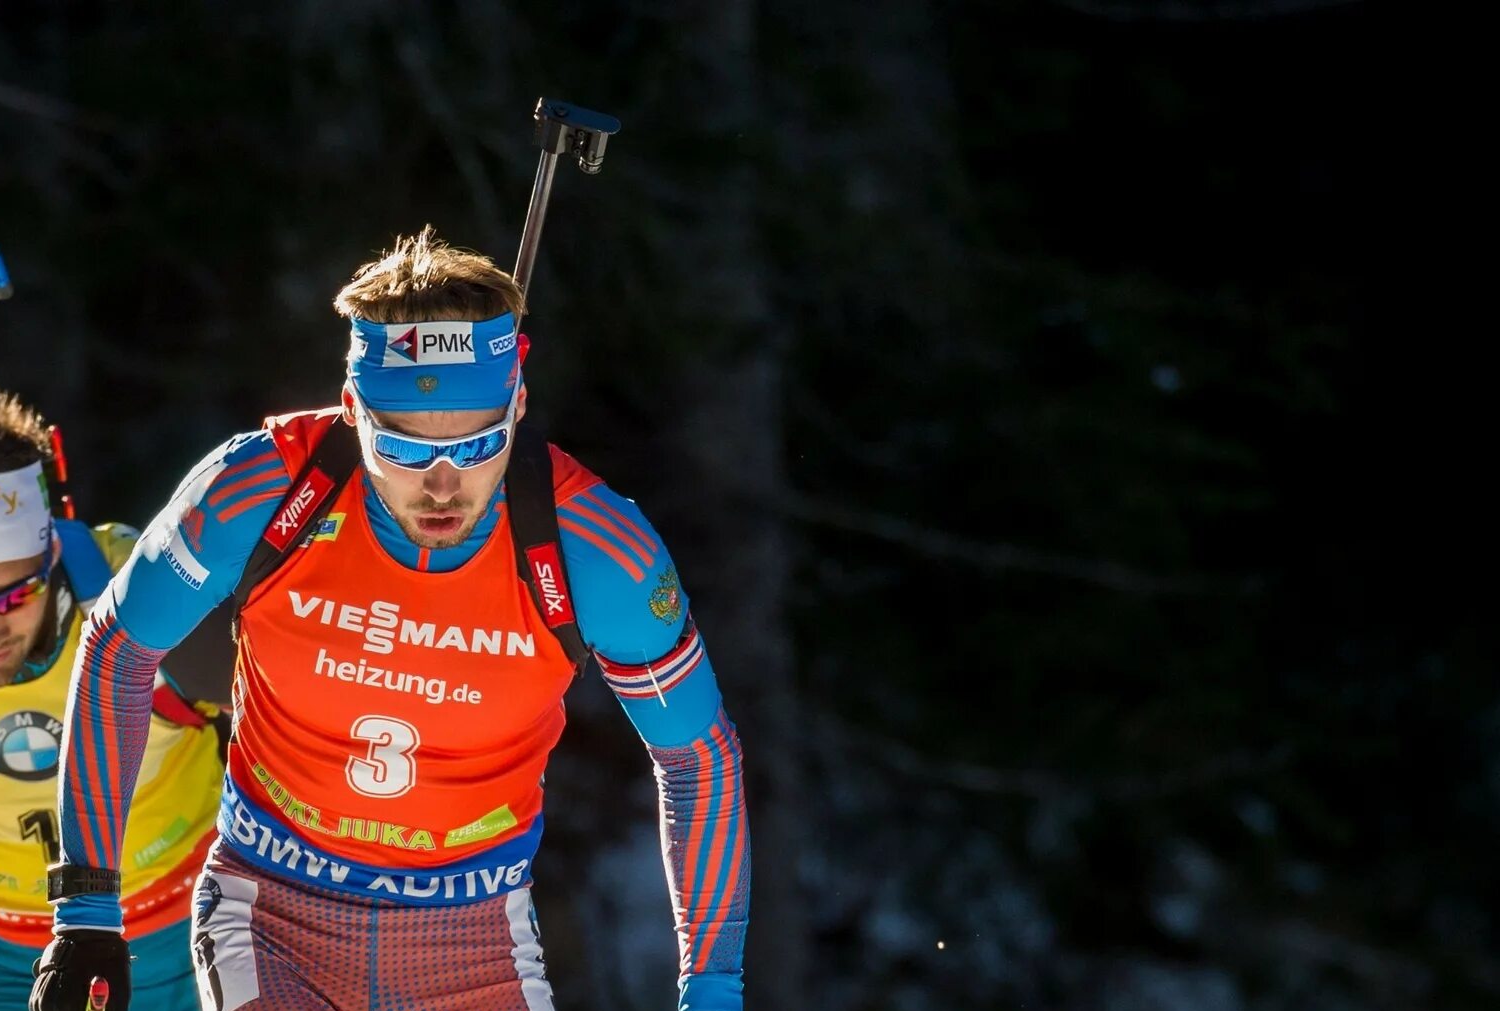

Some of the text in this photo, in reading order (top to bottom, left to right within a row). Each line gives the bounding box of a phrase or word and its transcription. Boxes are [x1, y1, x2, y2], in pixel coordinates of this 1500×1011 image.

[314, 648, 482, 704] heizung.de
[345, 714, 421, 799] 3
[230, 801, 350, 884] BMW
